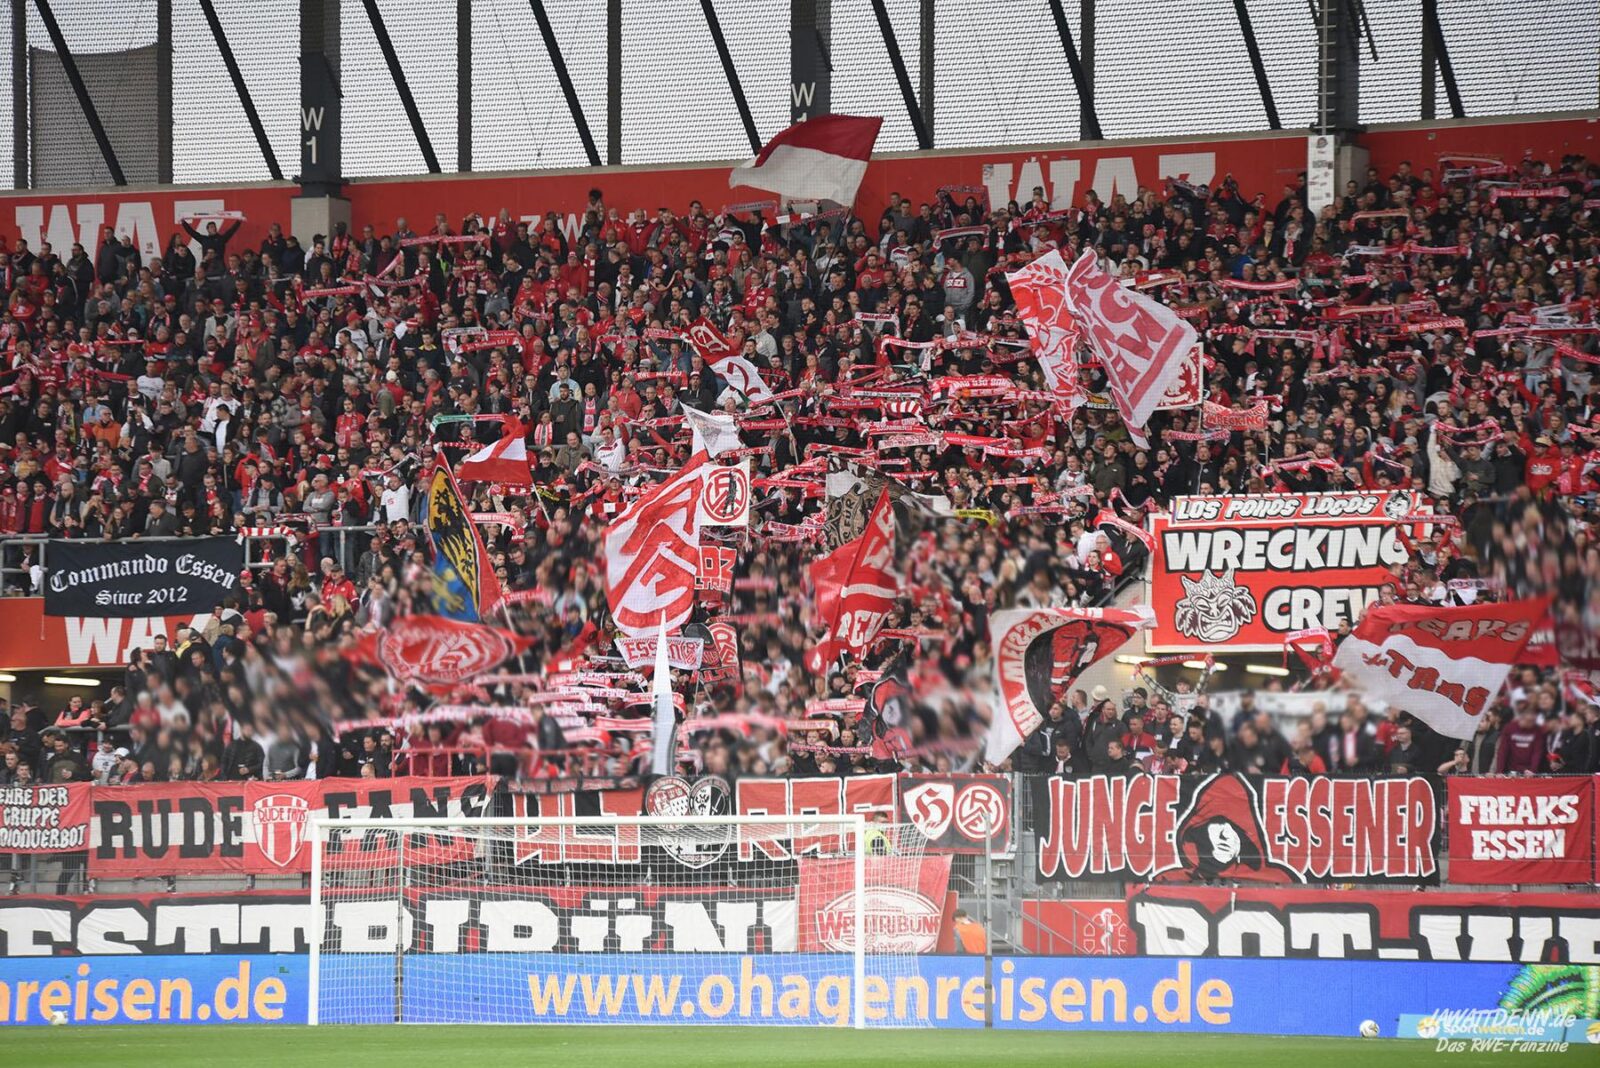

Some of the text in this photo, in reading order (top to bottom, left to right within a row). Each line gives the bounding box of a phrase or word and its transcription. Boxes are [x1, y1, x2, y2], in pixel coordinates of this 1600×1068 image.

[790, 82, 816, 107] W
[301, 106, 325, 131] W
[306, 136, 317, 164] 1
[1176, 499, 1222, 521] LOS
[1302, 495, 1379, 518] LOCOS
[1163, 525, 1411, 573] WRECKING
[49, 552, 238, 593] Commando Essen
[94, 586, 189, 606] Since 2012
[38, 786, 69, 806] DER
[1459, 794, 1580, 826] FREAKS
[3, 806, 61, 828] GRUPPE
[95, 796, 245, 860] RUDE
[258, 807, 287, 824] RUDE
[1039, 774, 1437, 878] JUNGE ESSENER
[1471, 828, 1566, 861] ESSEN
[528, 956, 1234, 1027] www.ohagenreisen.de
